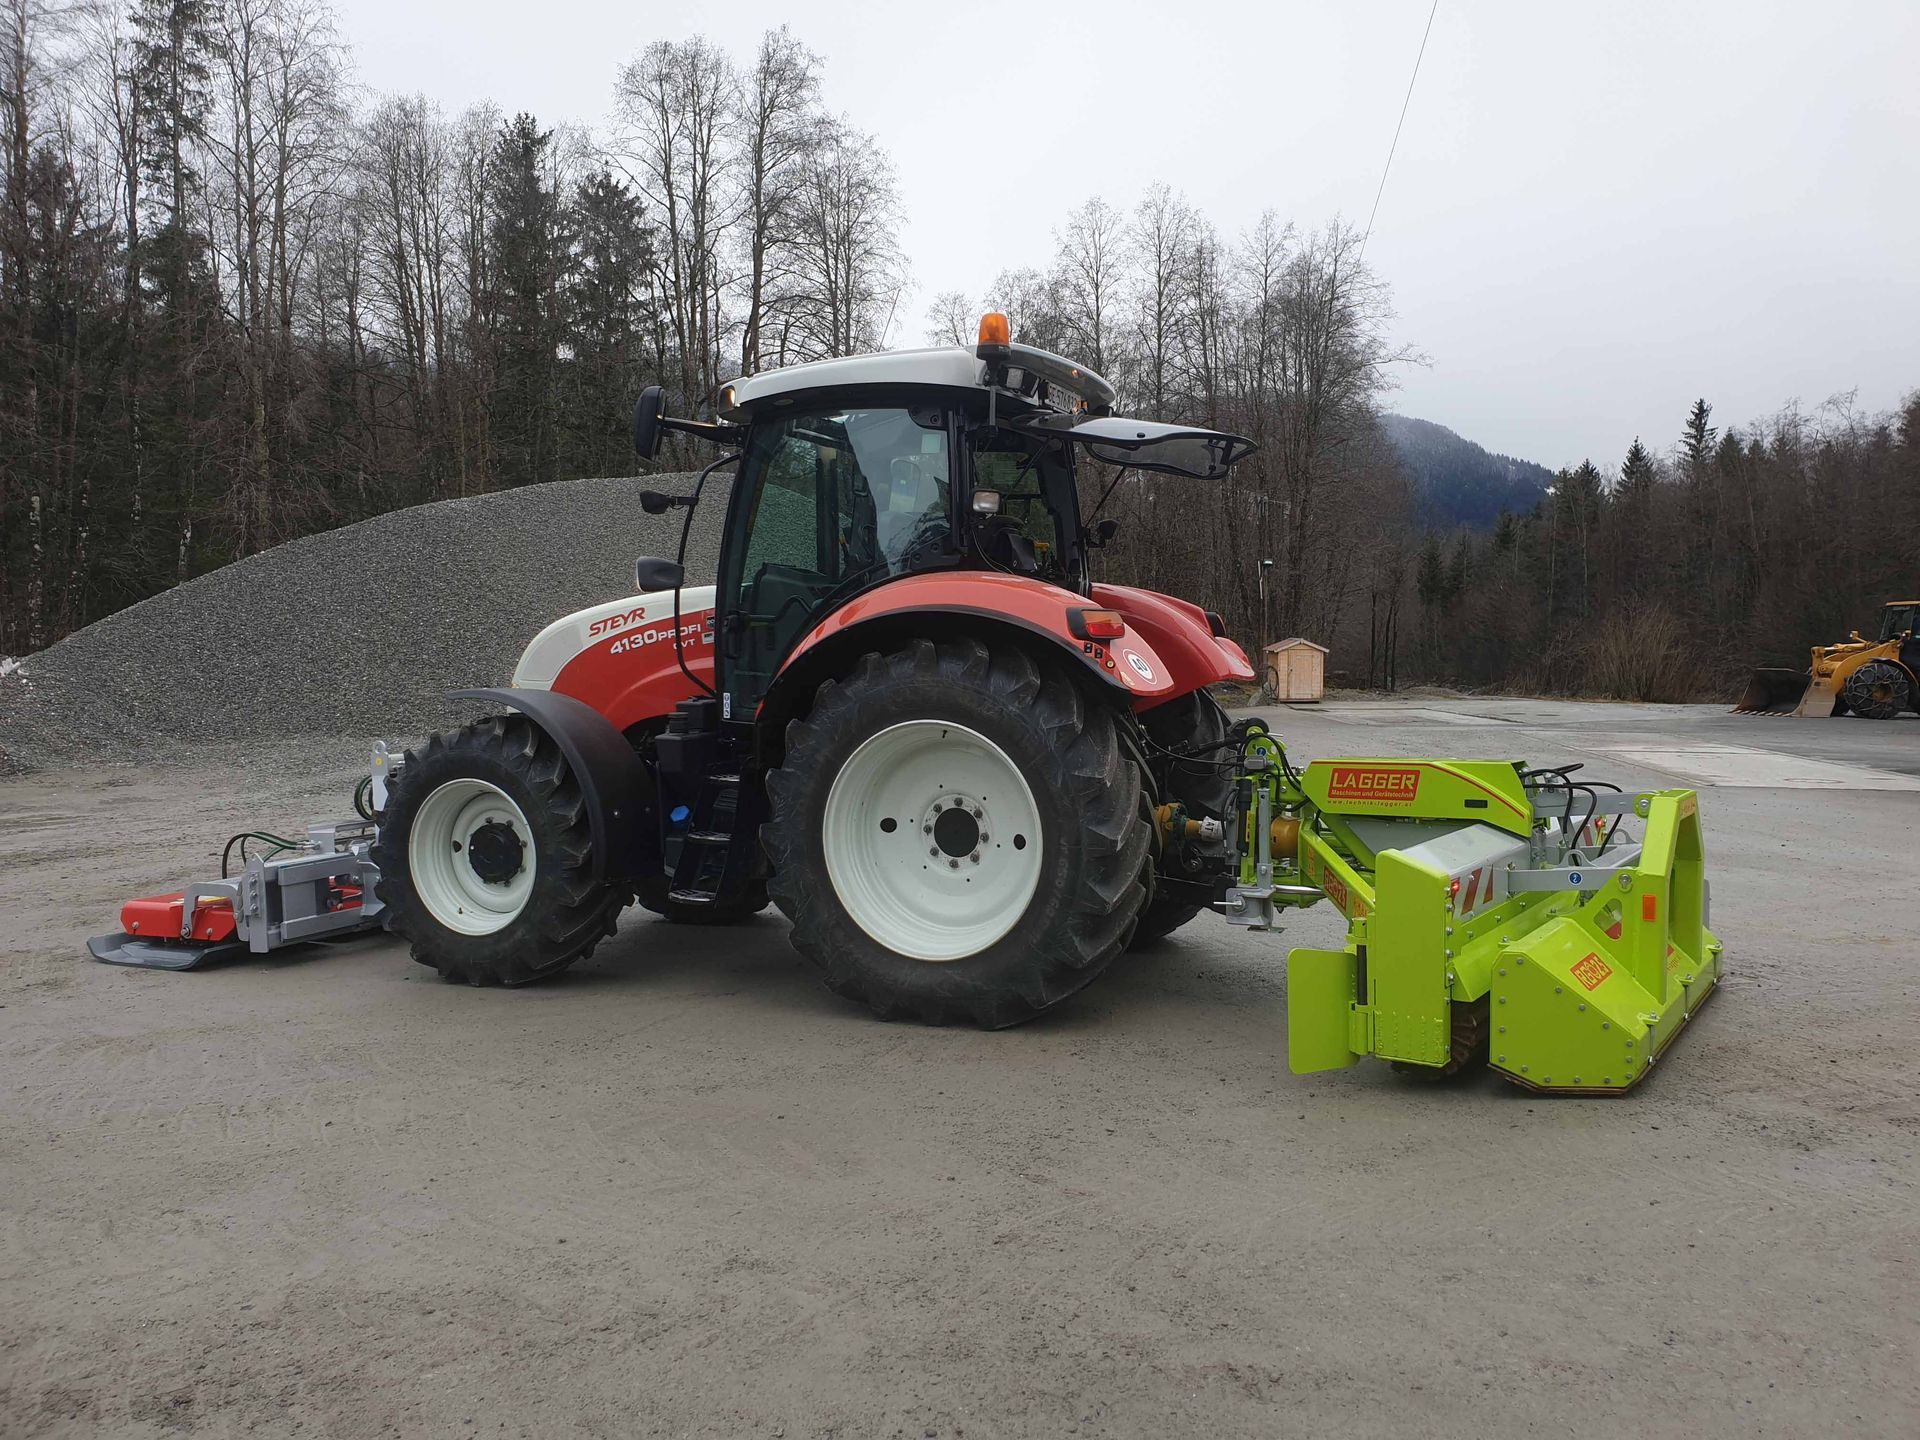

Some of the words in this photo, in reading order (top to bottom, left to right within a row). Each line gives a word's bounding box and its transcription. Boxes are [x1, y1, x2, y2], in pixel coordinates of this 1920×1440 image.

[589, 607, 645, 637] STEYR
[610, 629, 657, 655] 4130
[1332, 773, 1416, 790] LAGGER
[1331, 789, 1361, 797] Maschinen
